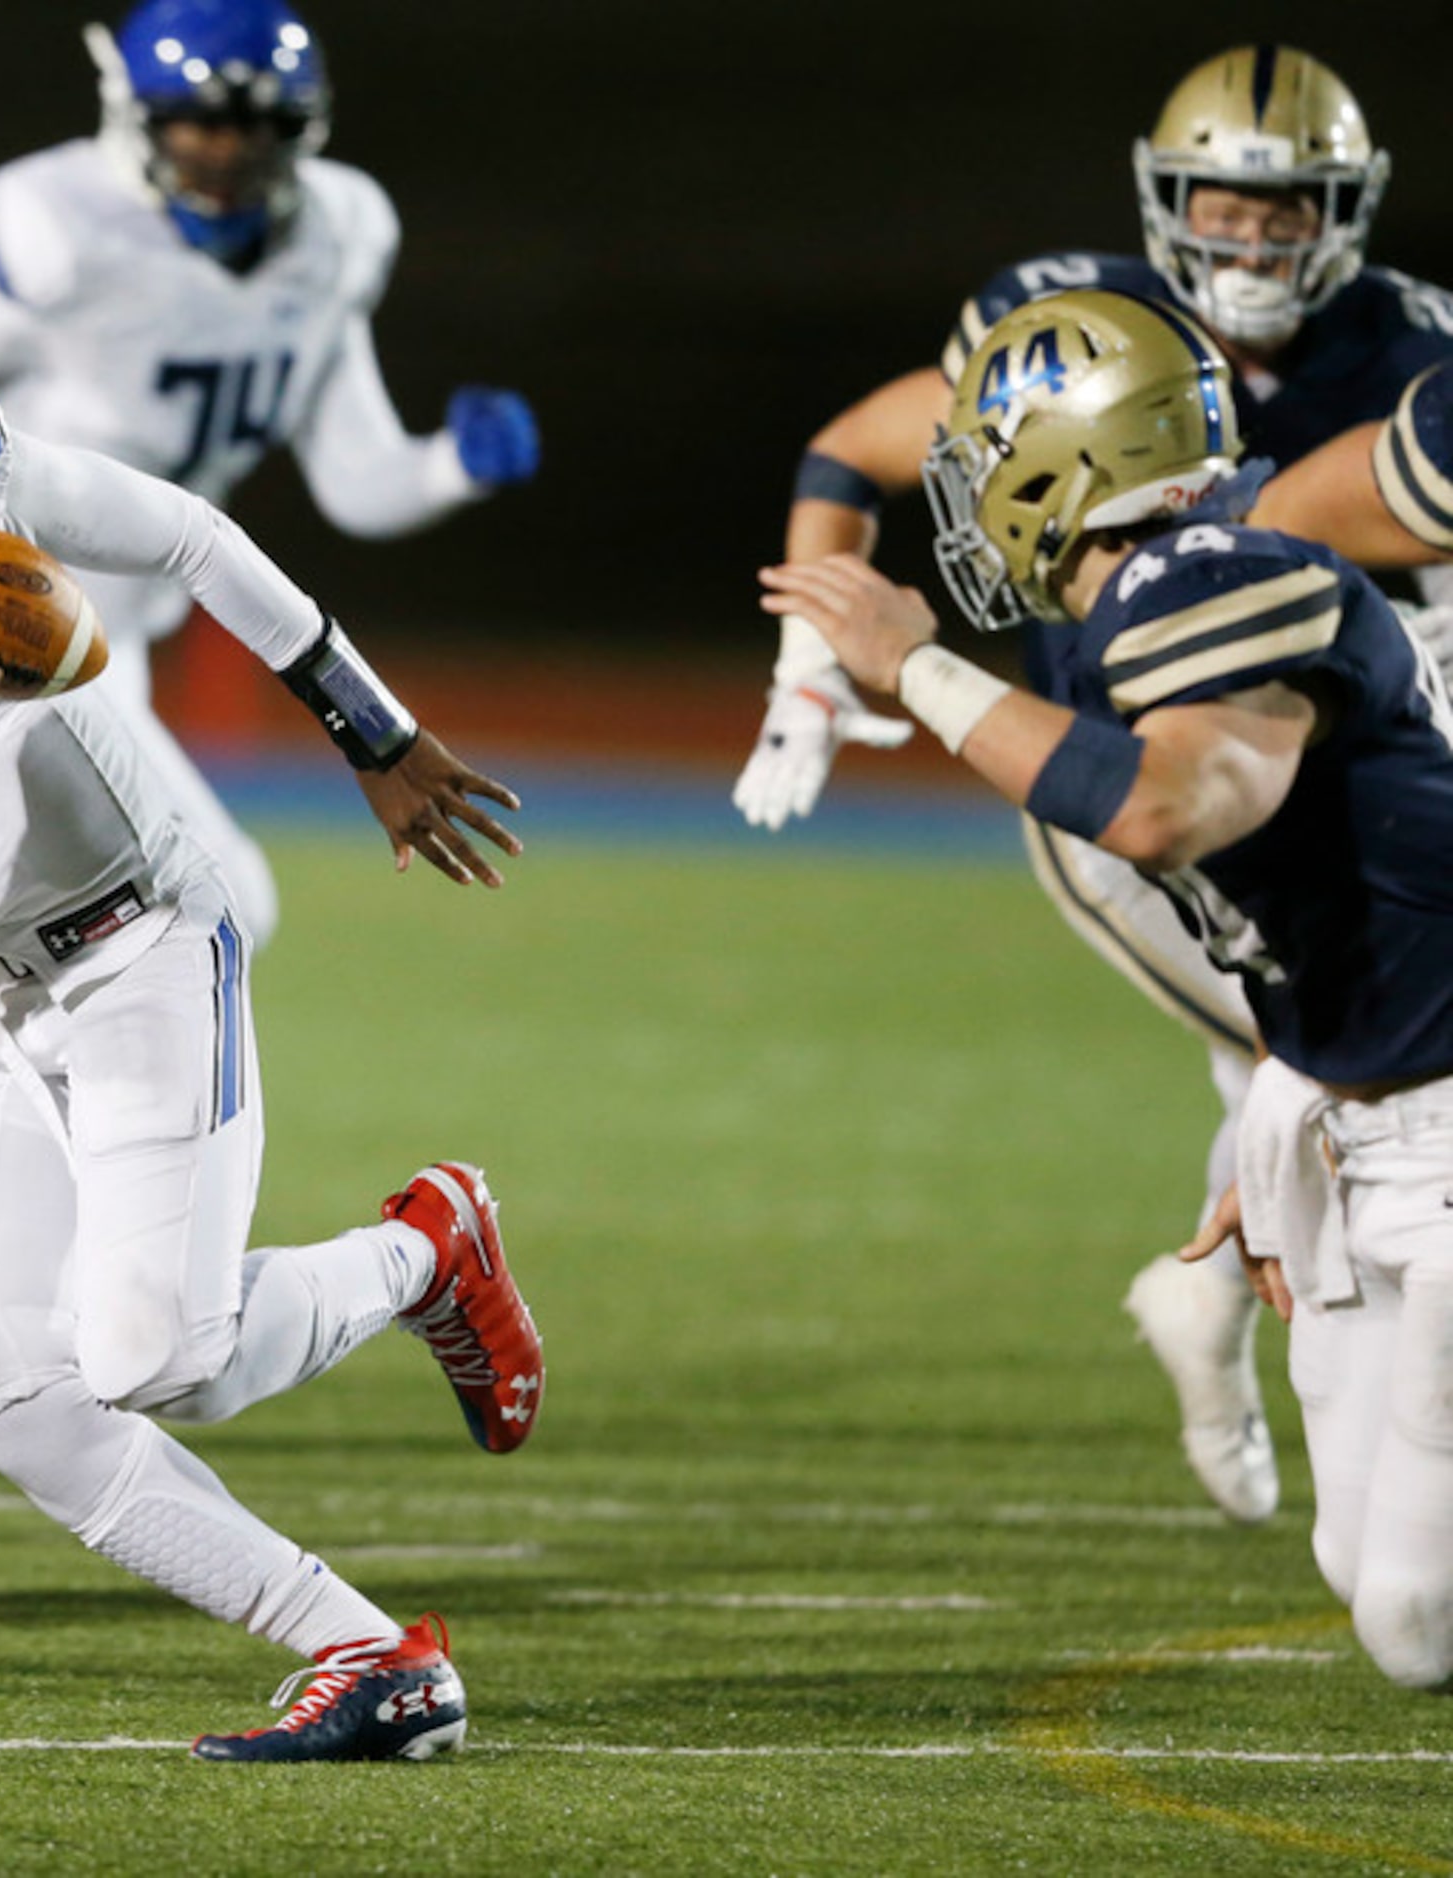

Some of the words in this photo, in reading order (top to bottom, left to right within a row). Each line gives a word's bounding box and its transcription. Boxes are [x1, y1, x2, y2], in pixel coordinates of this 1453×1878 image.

[1017, 255, 1099, 301] 2
[976, 326, 1068, 418] 44
[157, 351, 294, 484] 74
[1117, 524, 1236, 602] 44
